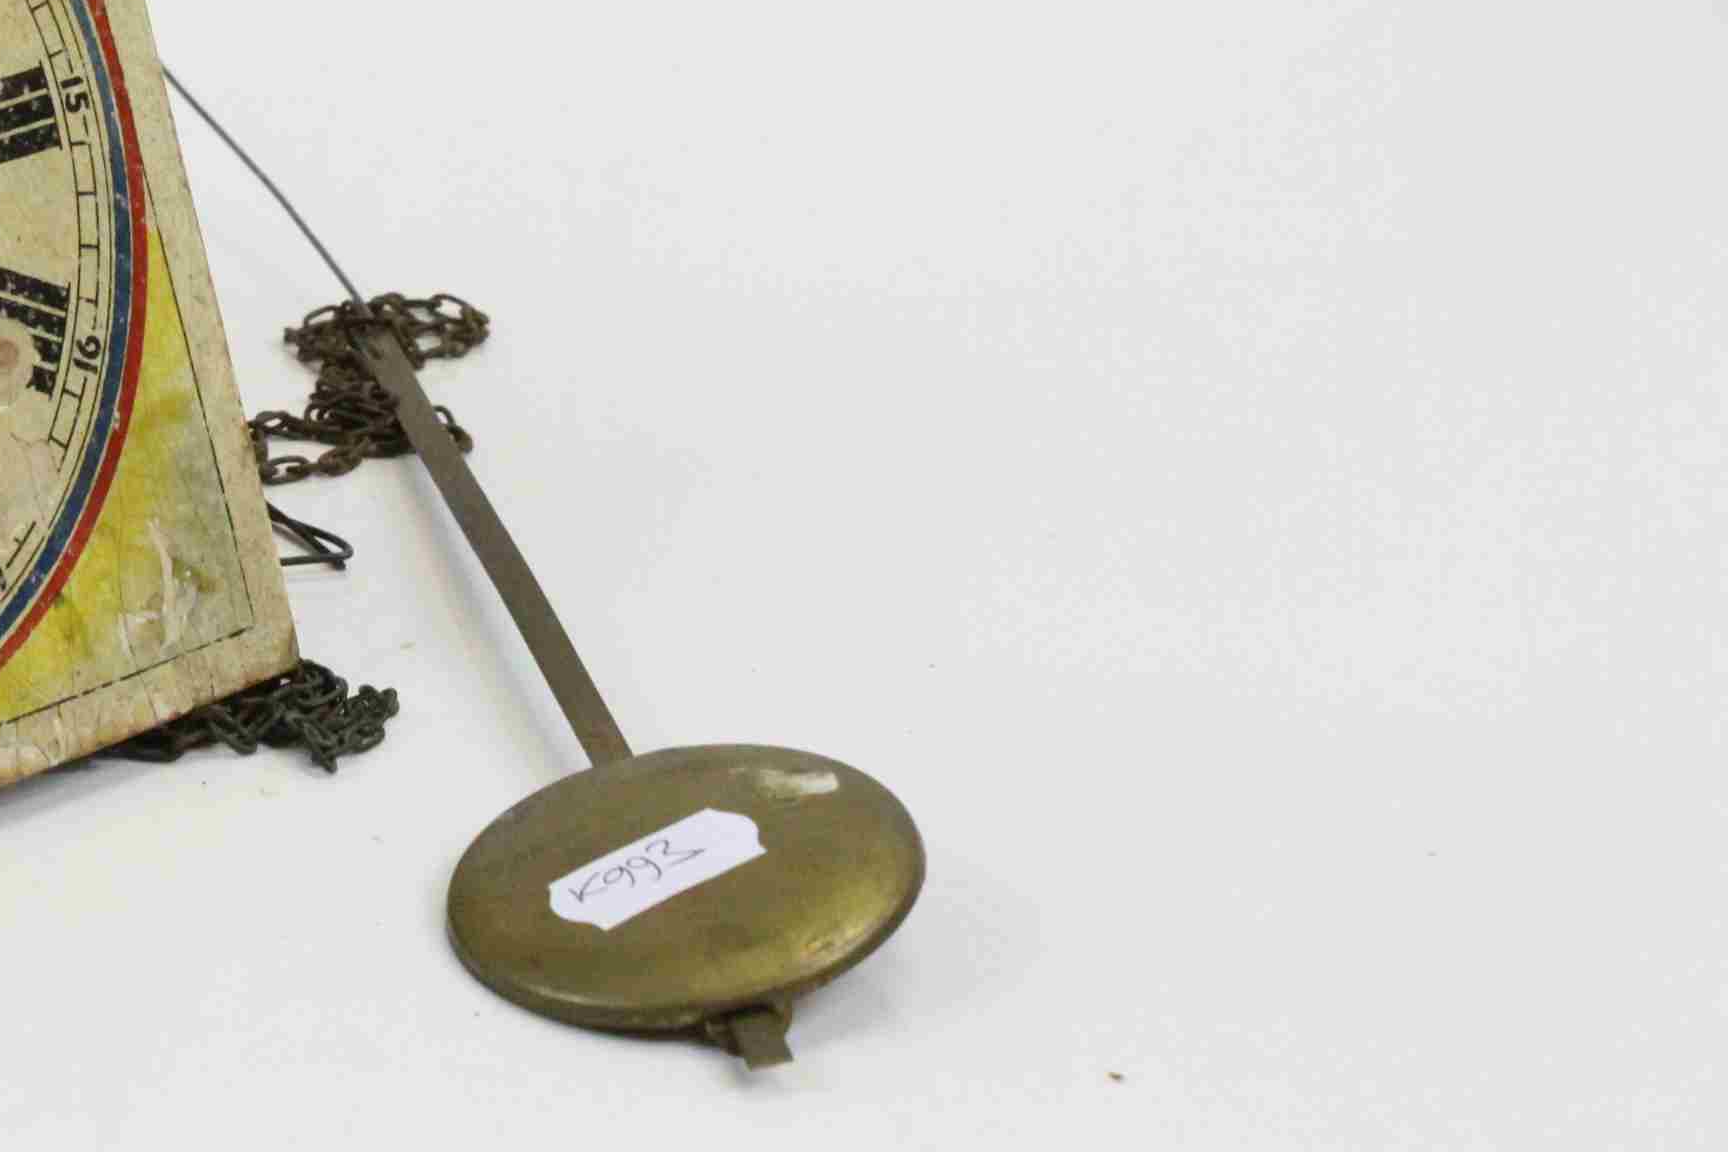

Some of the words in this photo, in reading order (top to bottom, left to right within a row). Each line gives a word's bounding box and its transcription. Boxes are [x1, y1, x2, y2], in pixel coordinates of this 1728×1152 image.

[60, 75, 91, 114] 15
[73, 334, 102, 375] 16
[568, 838, 707, 905] K993
